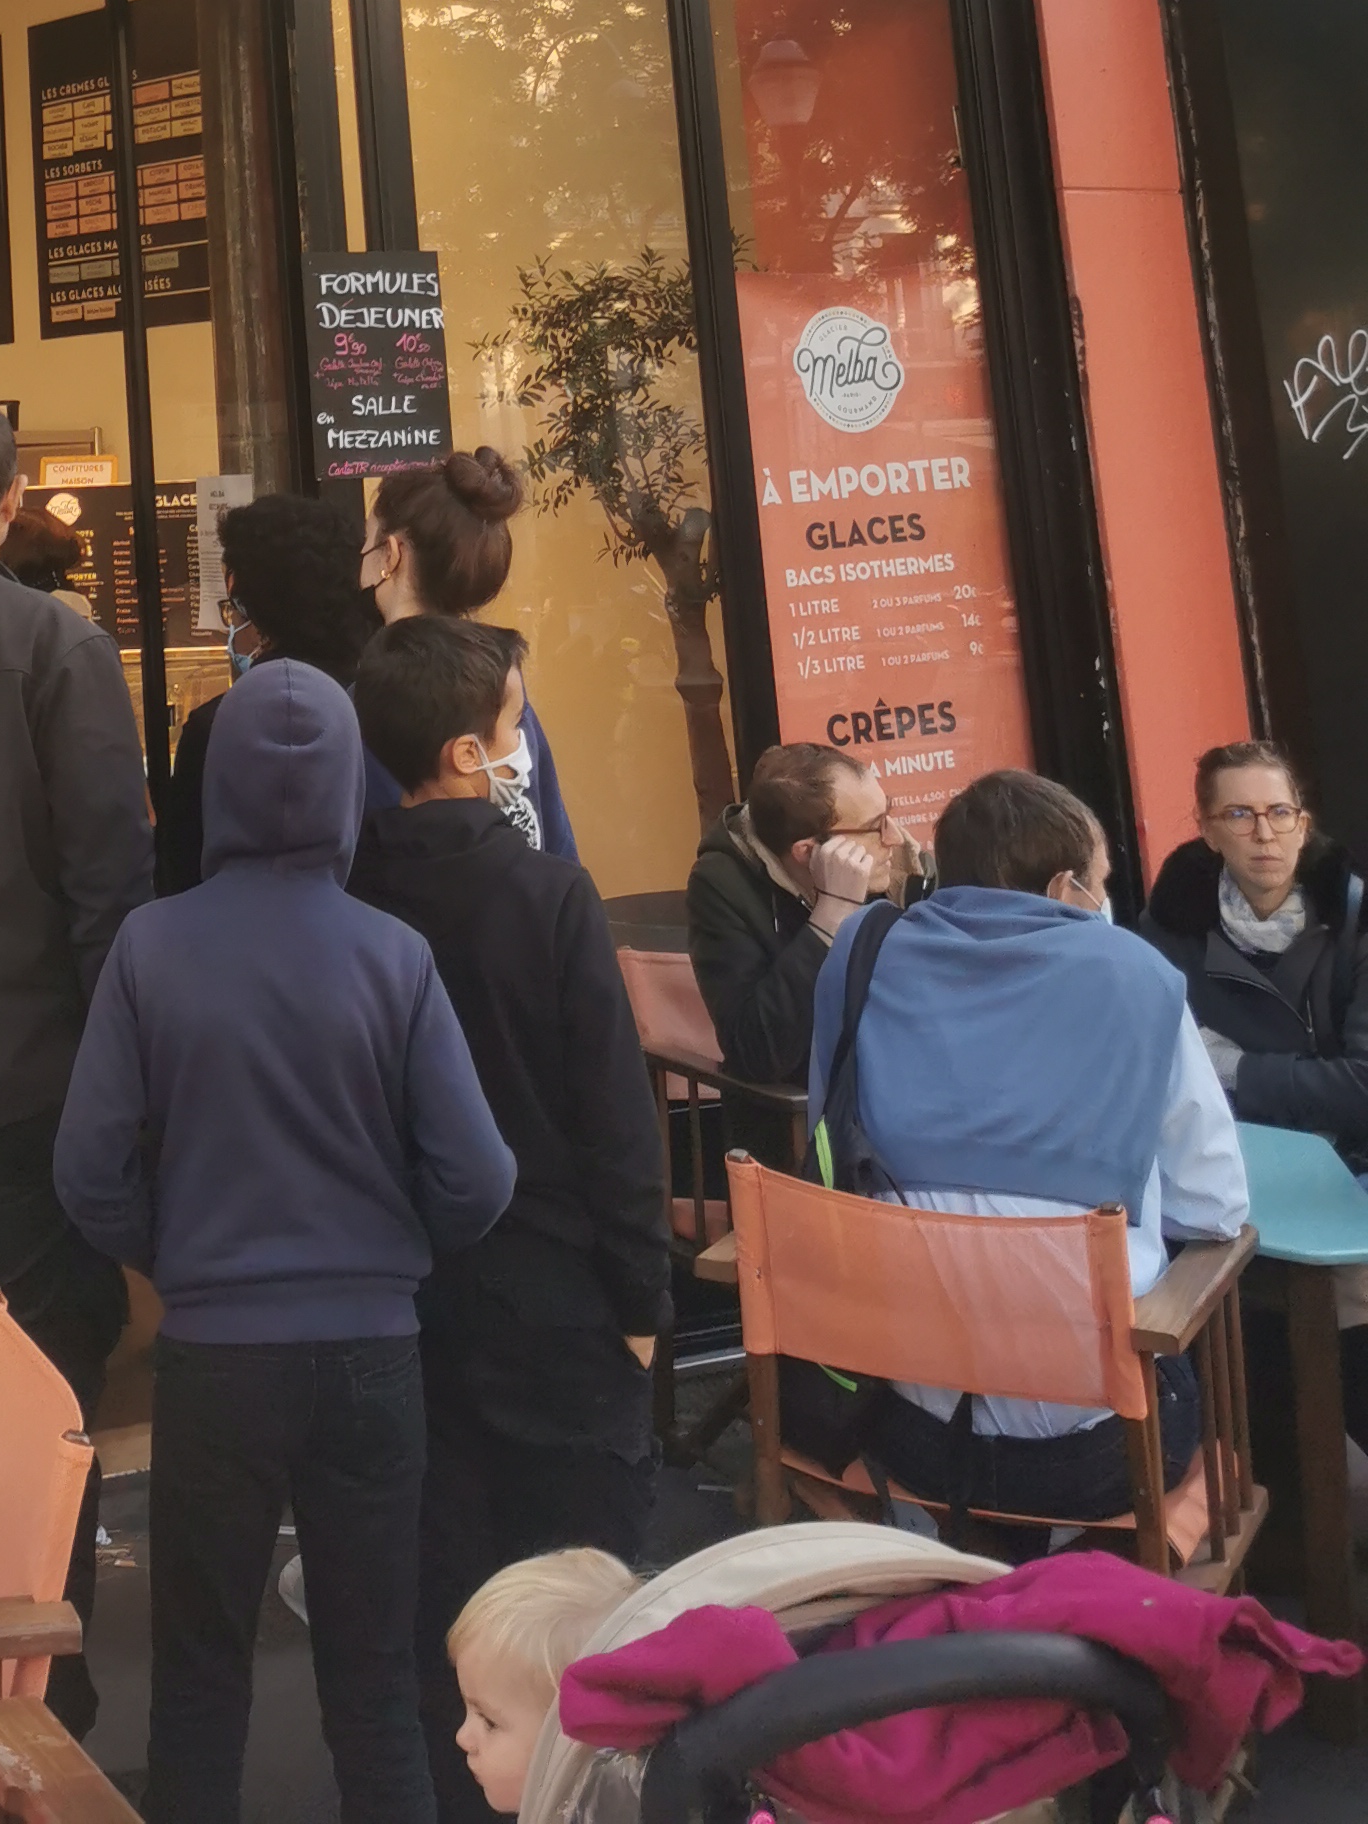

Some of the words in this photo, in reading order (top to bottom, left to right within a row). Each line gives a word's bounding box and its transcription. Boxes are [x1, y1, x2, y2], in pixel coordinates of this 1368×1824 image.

[41, 86, 57, 100] LES
[45, 165, 60, 179] LES
[62, 159, 103, 175] SORBETS
[48, 246, 64, 259] LES
[66, 241, 101, 256] GLACES
[50, 291, 66, 303] LES
[68, 285, 104, 301] GLACES
[319, 269, 439, 296] FORMULES
[797, 326, 901, 398] Melba
[351, 394, 417, 416] SALLE
[316, 411, 335, 425] en
[52, 464, 104, 473] CONFITURES
[61, 477, 94, 485] MAISON
[762, 467, 782, 506] À
[789, 457, 971, 504] EMPORTER
[156, 494, 198, 508] GLACE
[805, 513, 926, 551] GLACES
[785, 564, 836, 588] BACS
[839, 553, 955, 582] ISOTHERMES
[789, 602, 796, 617] 1
[799, 598, 840, 617] LITRE
[872, 599, 878, 609] 2
[880, 597, 893, 608] OU
[902, 592, 943, 607] PARFUMS
[792, 626, 816, 650] 1/2
[818, 626, 862, 645] LITRE
[883, 626, 897, 637] OU
[905, 621, 945, 635] PARFUMS
[797, 655, 821, 679] 1/3
[824, 654, 866, 674] LITRE
[888, 655, 902, 666] OU
[910, 649, 950, 664] PARFUMS
[826, 697, 957, 747] CRÊPES
[868, 759, 882, 779] A
[884, 749, 956, 777] MINUTE
[890, 795, 921, 807] TELLA
